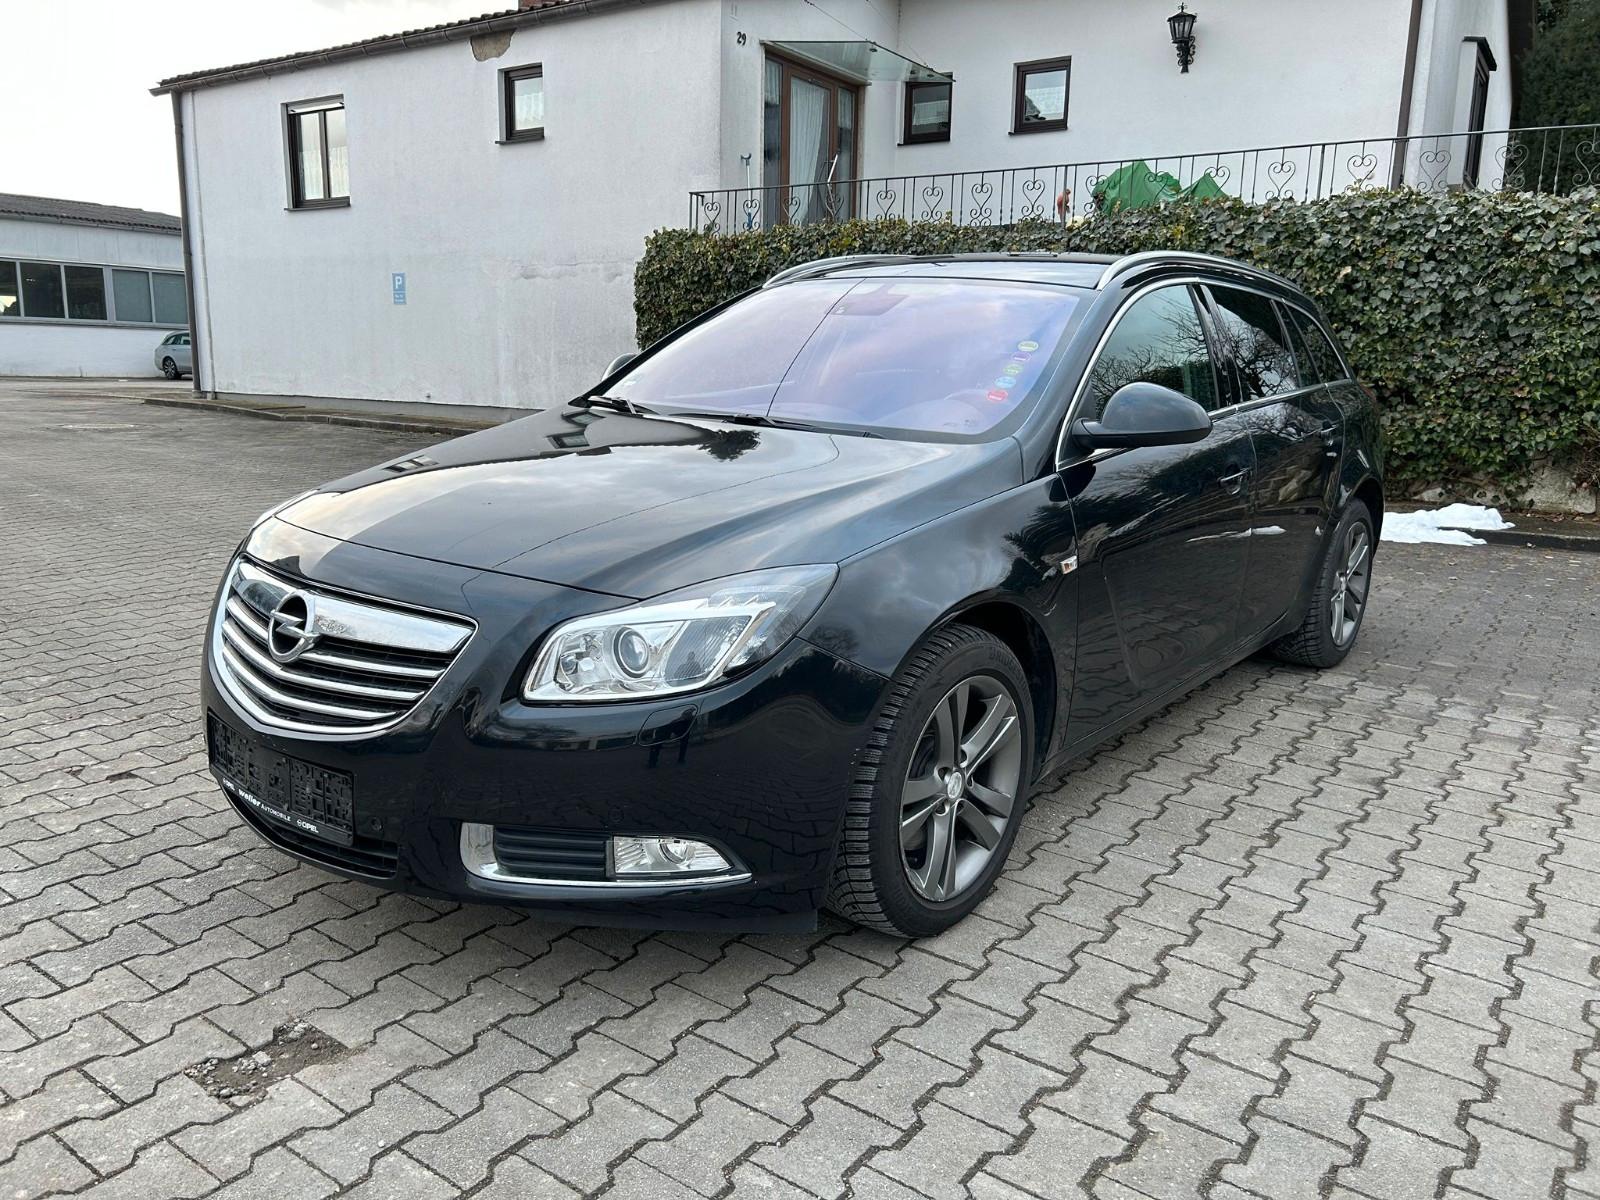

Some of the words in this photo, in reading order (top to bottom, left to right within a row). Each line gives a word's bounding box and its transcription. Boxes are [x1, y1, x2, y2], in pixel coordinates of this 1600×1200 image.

[736, 31, 747, 46] 29
[395, 276, 403, 289] P
[261, 803, 292, 822] AUTOMOBILE
[302, 822, 319, 833] OPEL
